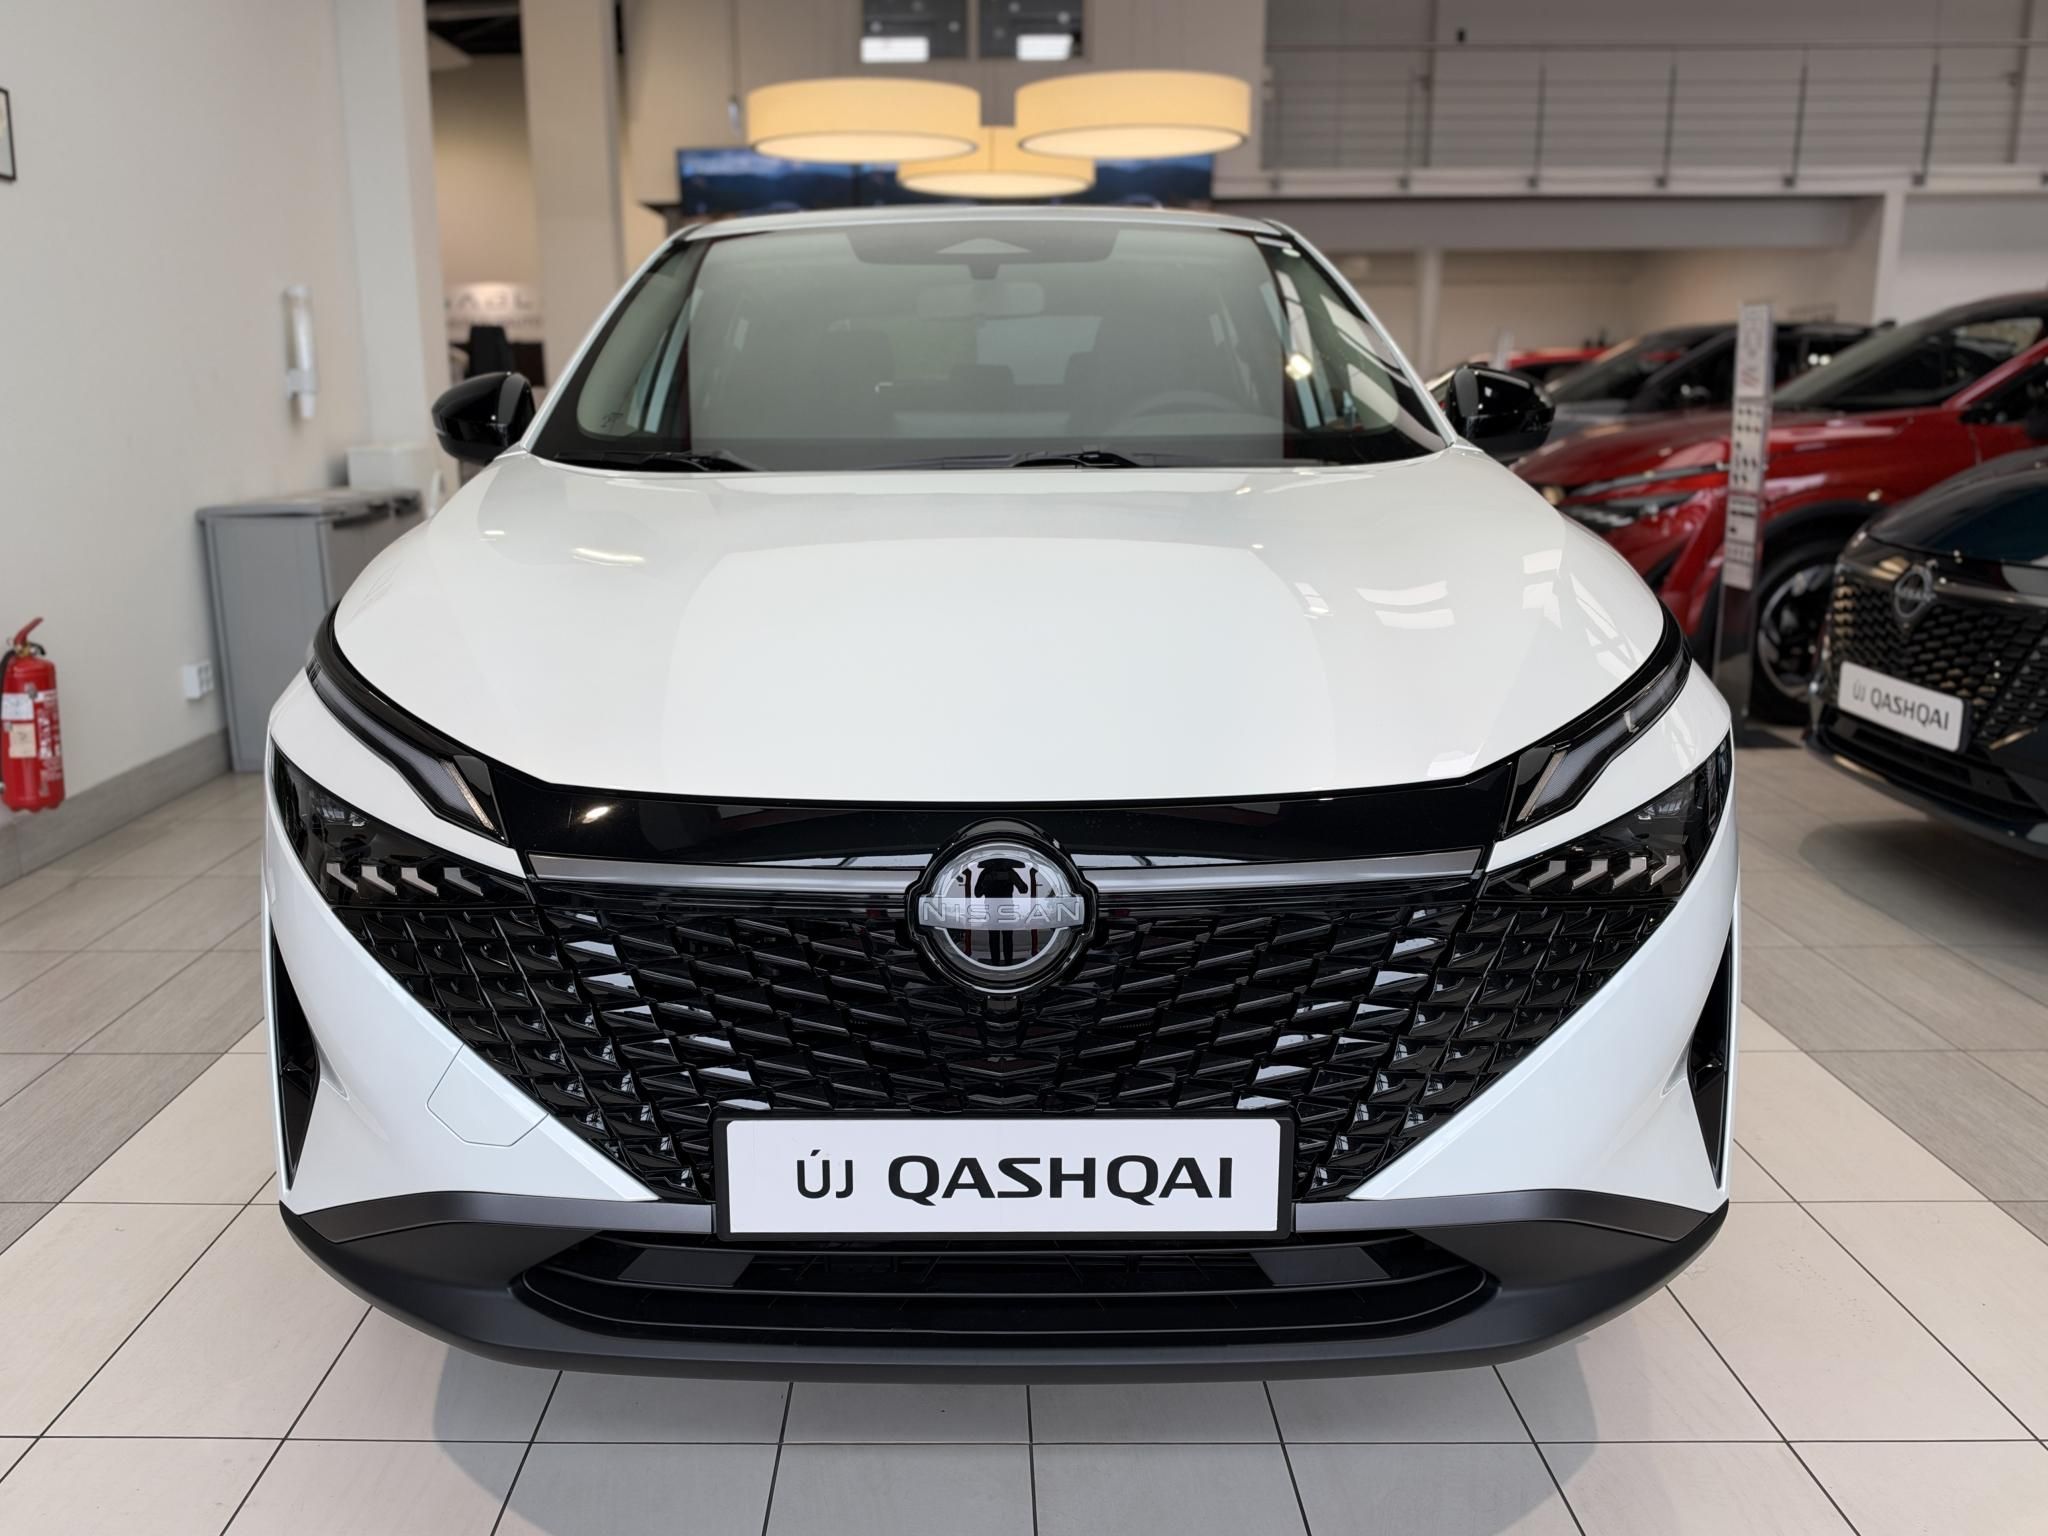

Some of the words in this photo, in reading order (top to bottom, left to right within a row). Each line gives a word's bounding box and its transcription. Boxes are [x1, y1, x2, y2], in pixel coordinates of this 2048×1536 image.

[1870, 687, 1949, 730] QASHQAI
[923, 901, 1080, 924] NISSAN
[796, 1149, 854, 1199] ÚJ
[888, 1155, 1233, 1207] QASHQAI
